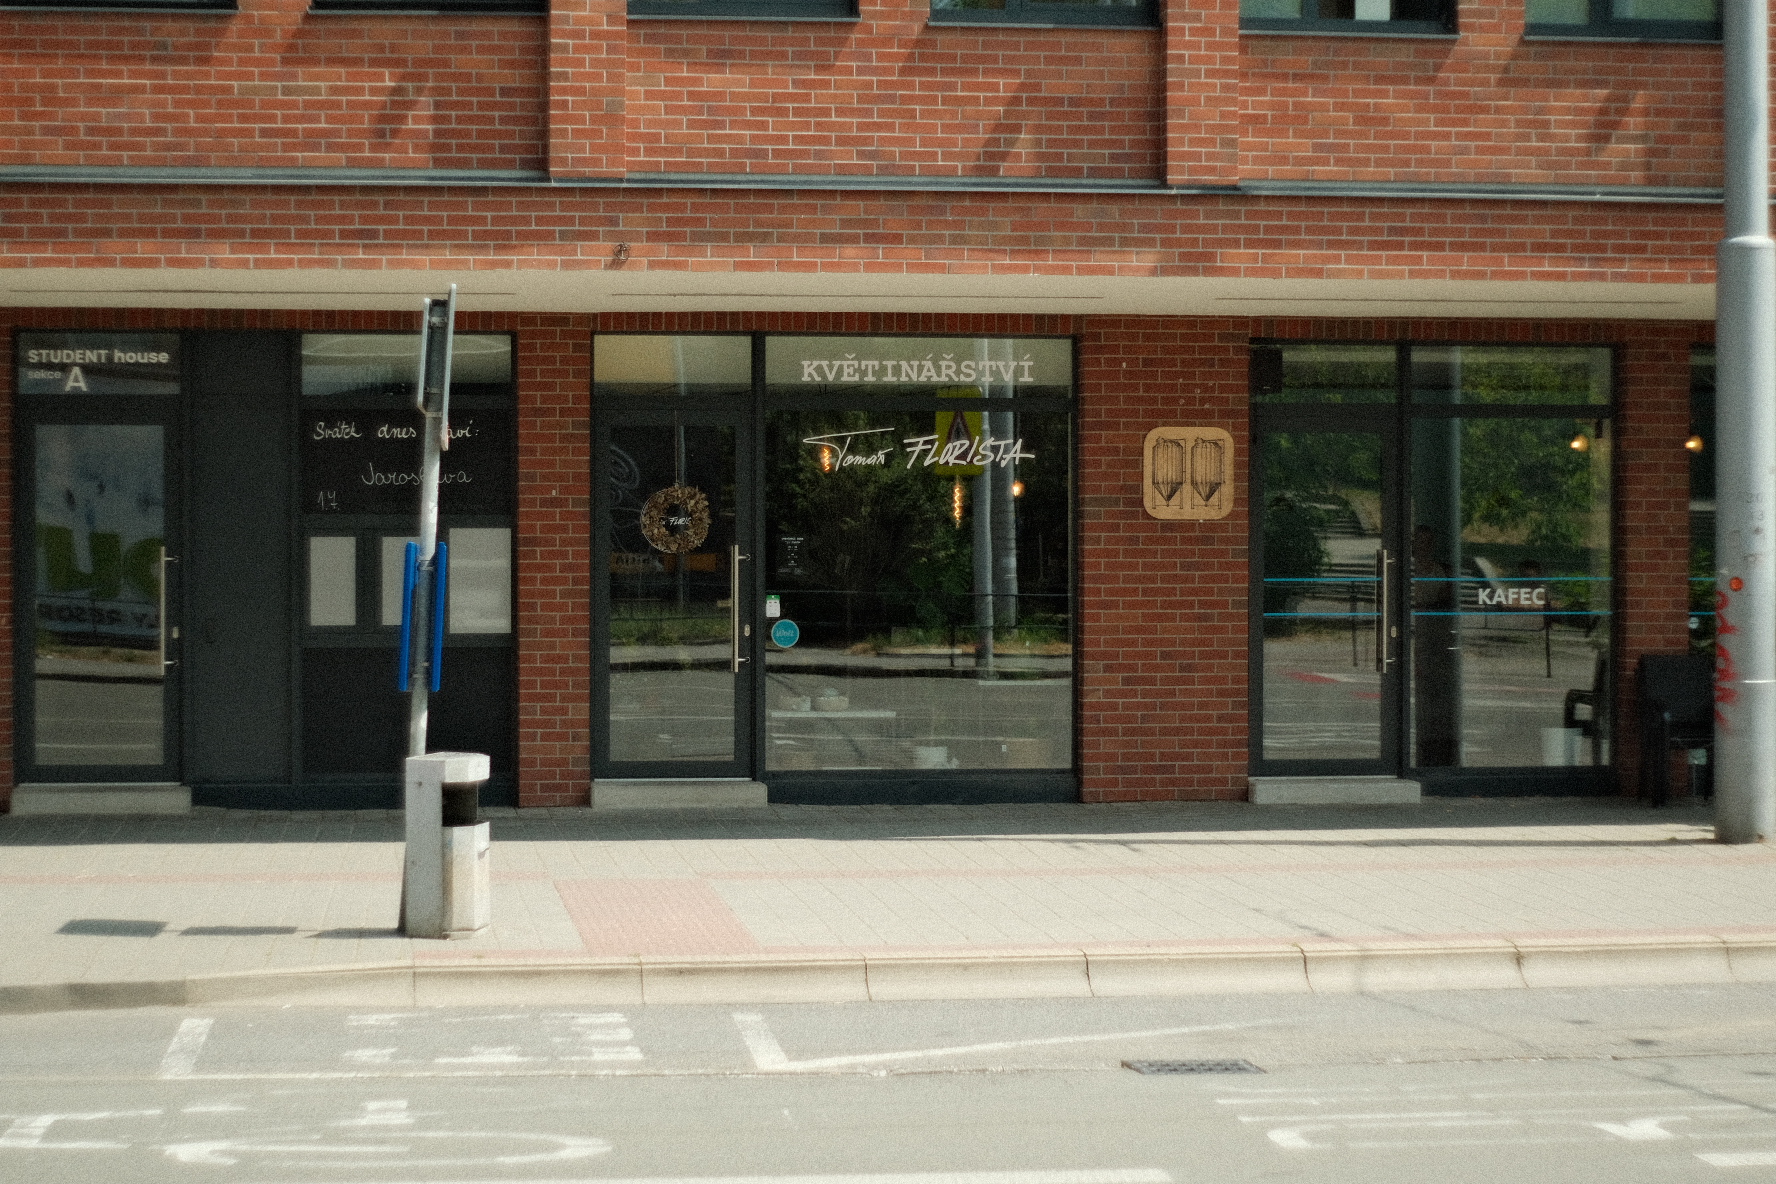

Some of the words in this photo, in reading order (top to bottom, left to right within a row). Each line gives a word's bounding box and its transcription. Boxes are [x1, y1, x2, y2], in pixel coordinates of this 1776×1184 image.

[28, 350, 108, 363] STUDENT
[114, 350, 169, 363] house
[801, 353, 1034, 382] KVĚTINÁŘSTVÍ
[27, 369, 62, 379] sekce
[65, 366, 88, 391] A
[378, 424, 417, 438] dnes
[903, 434, 1036, 469] FLORISTA
[1478, 588, 1547, 605] KAFEC
